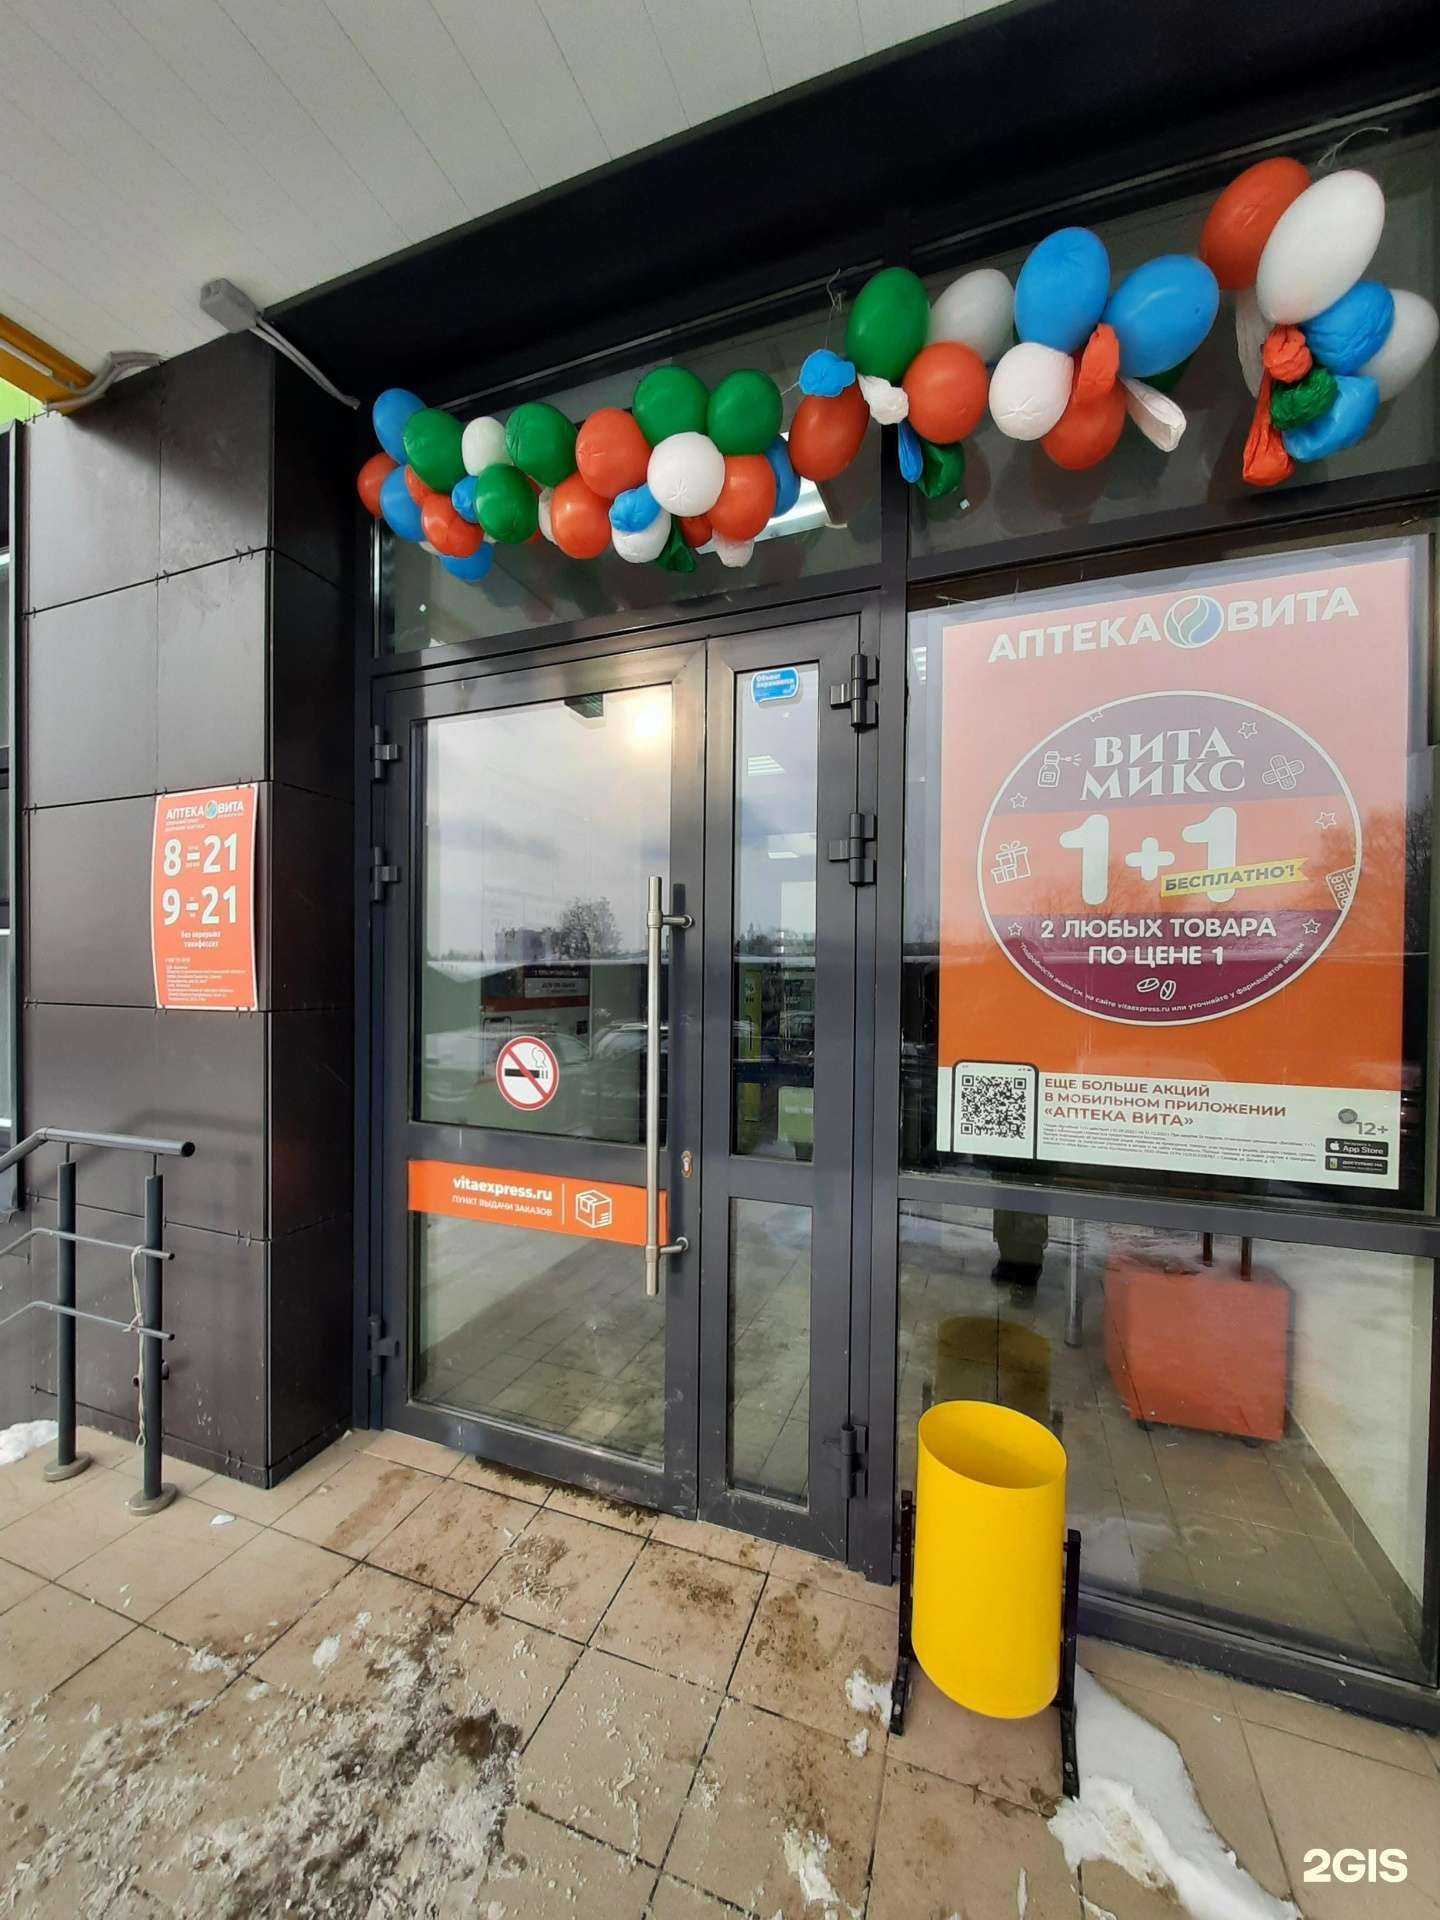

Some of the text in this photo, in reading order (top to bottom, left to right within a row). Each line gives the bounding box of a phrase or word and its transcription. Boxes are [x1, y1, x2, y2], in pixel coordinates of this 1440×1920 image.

[988, 586, 1359, 662] АПТЕКА ВИТА
[1093, 727, 1235, 767] ВИТА
[1080, 759, 1246, 801] МИКС
[166, 806, 204, 819] АПТЕКА
[218, 801, 244, 813] ВИТА
[1040, 917, 1277, 938] 2 ЛЮБЫХ ТОВАРА
[1088, 945, 1224, 968] ПО ЦЕНЕ 1
[1118, 1003, 1170, 1012] vitaexpress.ru
[1188, 995, 1229, 1011] уточняйте
[1045, 1078, 1210, 1097] ЕЩЕ БОЛЬШЕ АКЦИЙ
[1045, 1092, 1286, 1117] В МОБИЛЬНОМ ПРИЛОЖЕНИИ
[1044, 1106, 1194, 1126] «АПТЕКА ВИТА»
[1355, 1121, 1389, 1135] 12+
[1343, 1145, 1384, 1154] App Store
[453, 1175, 553, 1201] vitaexpress.ru
[452, 1195, 553, 1217] ПУНКТ ВЫДАЧИ ЗАКАЗОВ
